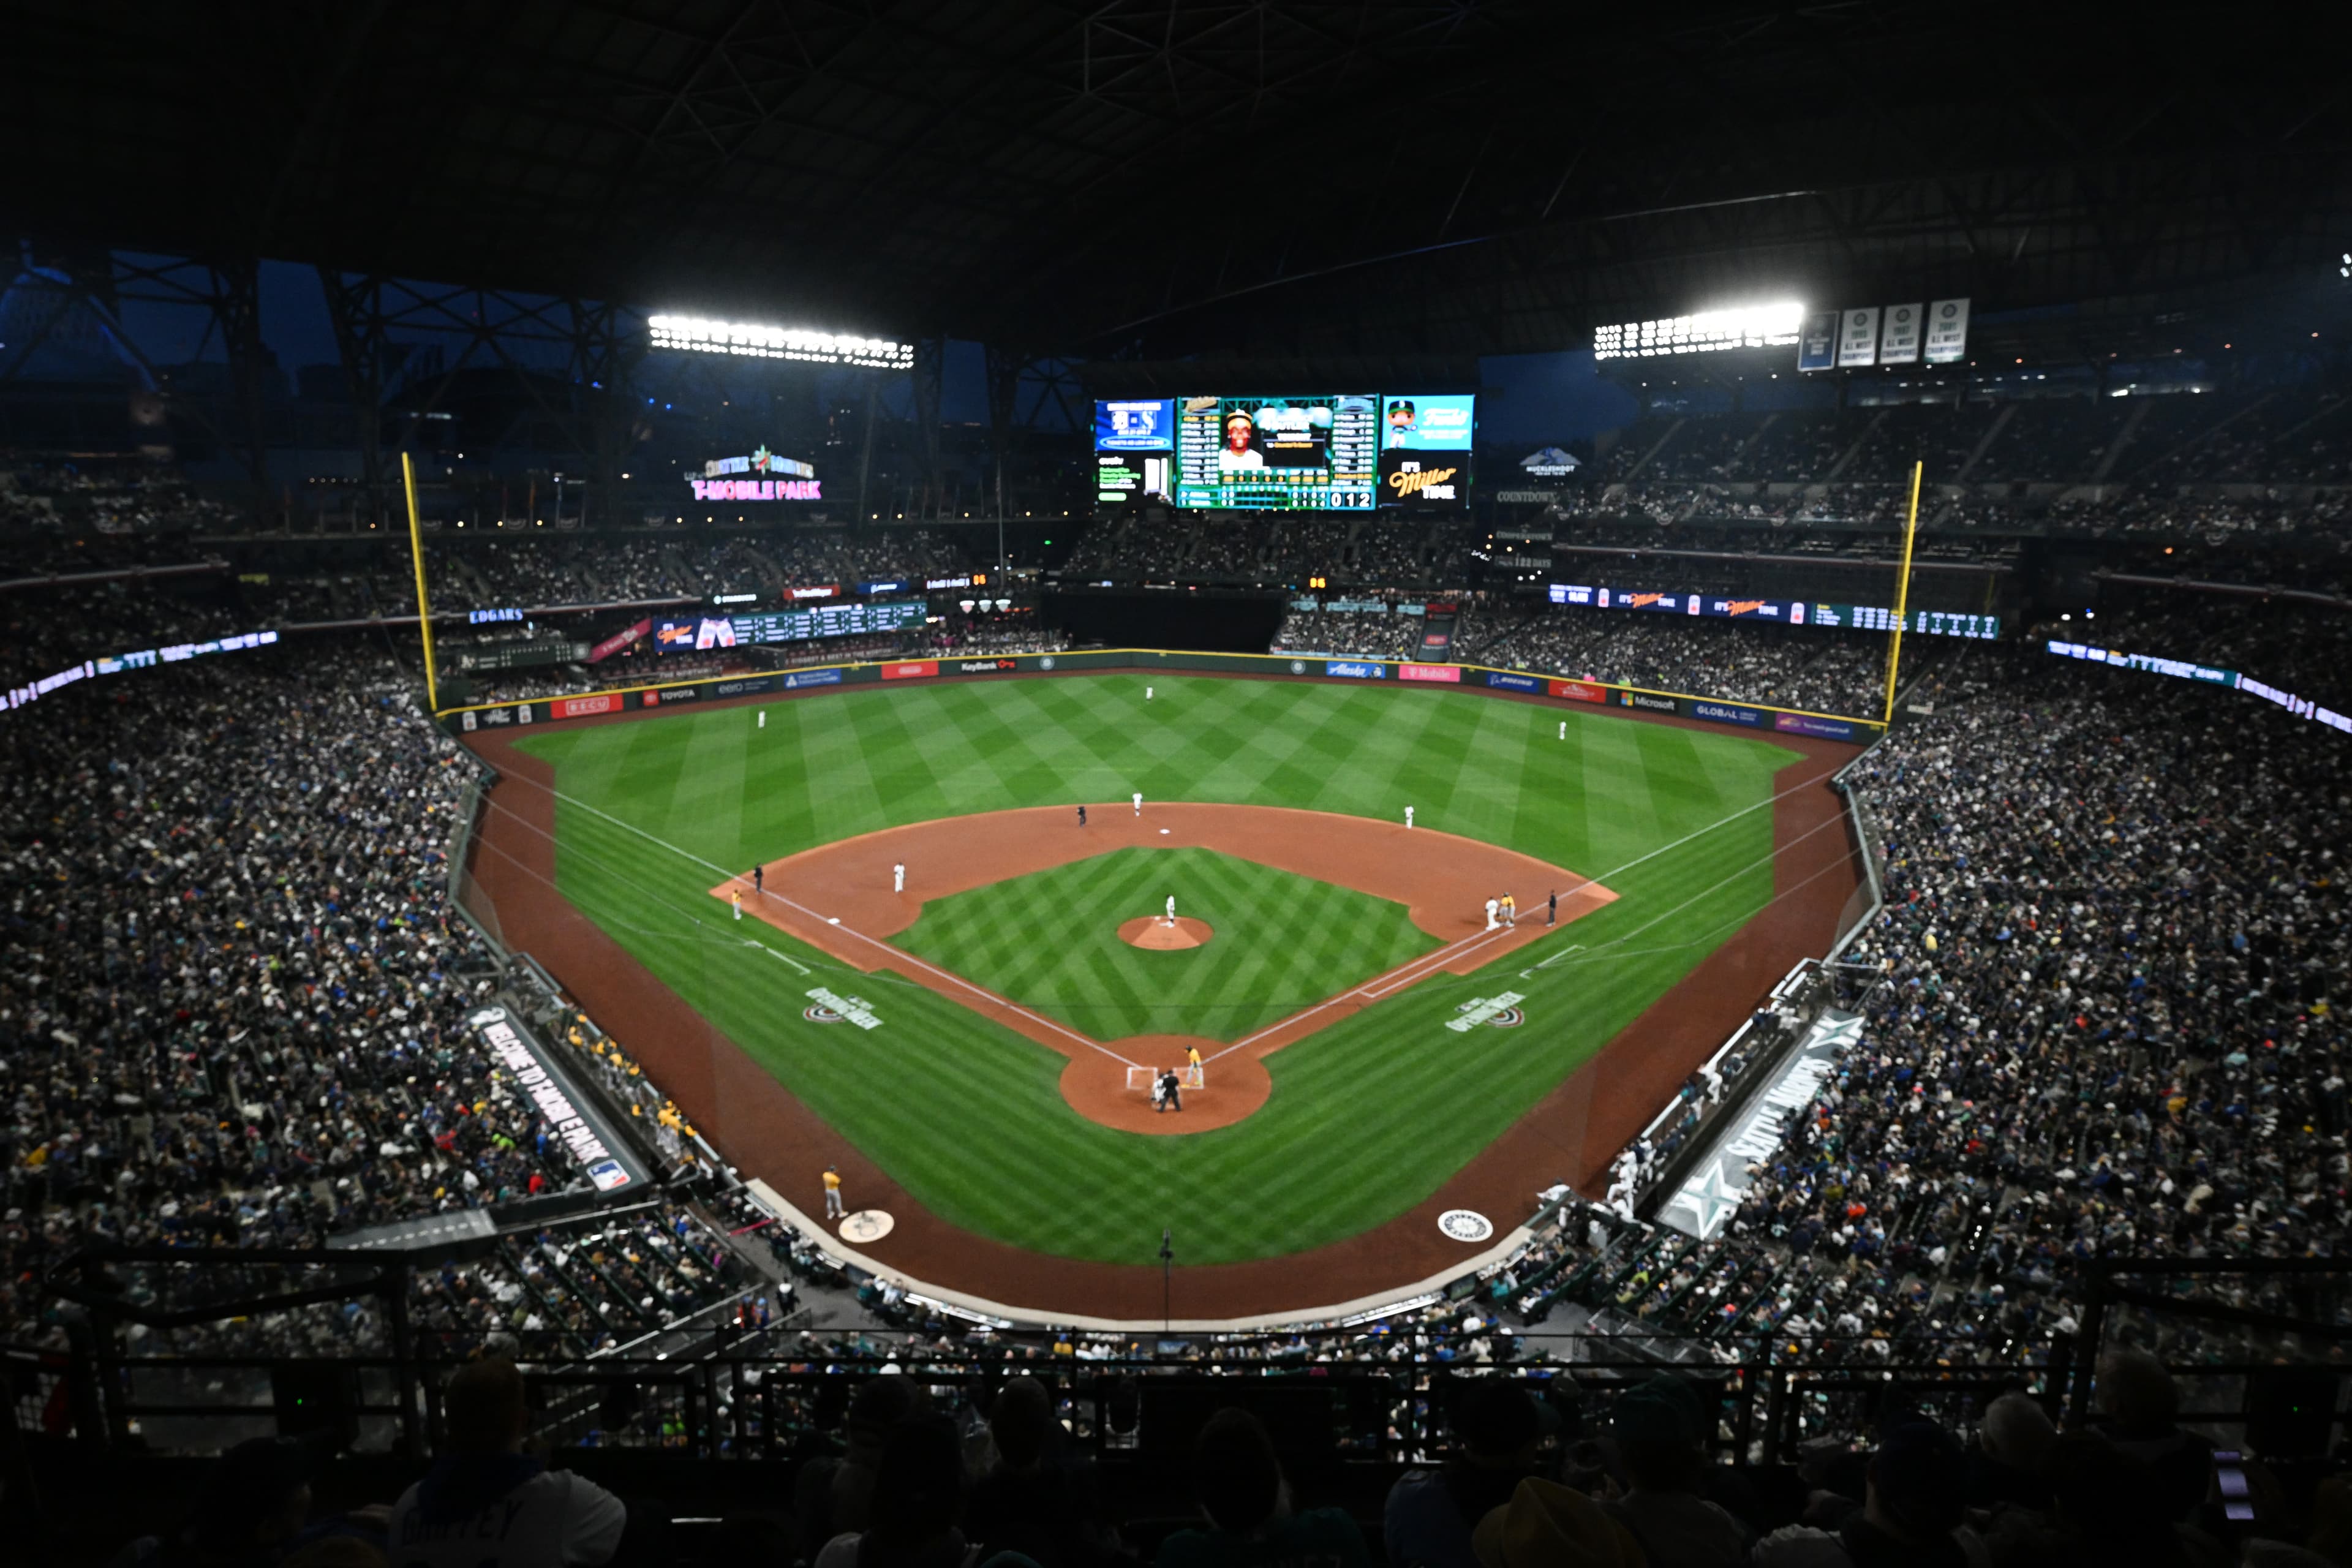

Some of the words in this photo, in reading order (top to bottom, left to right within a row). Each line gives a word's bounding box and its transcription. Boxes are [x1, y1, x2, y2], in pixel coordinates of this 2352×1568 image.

[691, 480, 775, 500] T-MOBILE
[775, 480, 821, 500] PARK
[1389, 468, 1457, 497] Miller
[1332, 492, 1341, 508] 0
[1346, 492, 1354, 508] 1
[1359, 492, 1370, 508] 2
[962, 661, 997, 672] KeyBank
[1329, 663, 1366, 676] Alaska
[1419, 668, 1450, 679] Mobile
[662, 690, 695, 701] TOYOTA
[1635, 696, 1675, 710] Microsoft
[1697, 706, 1738, 719] GLOBAL
[483, 1021, 537, 1071] WELCOME
[517, 1065, 547, 1085] TO
[527, 1078, 585, 1133] T-MOBILE
[562, 1125, 610, 1164] PARK
